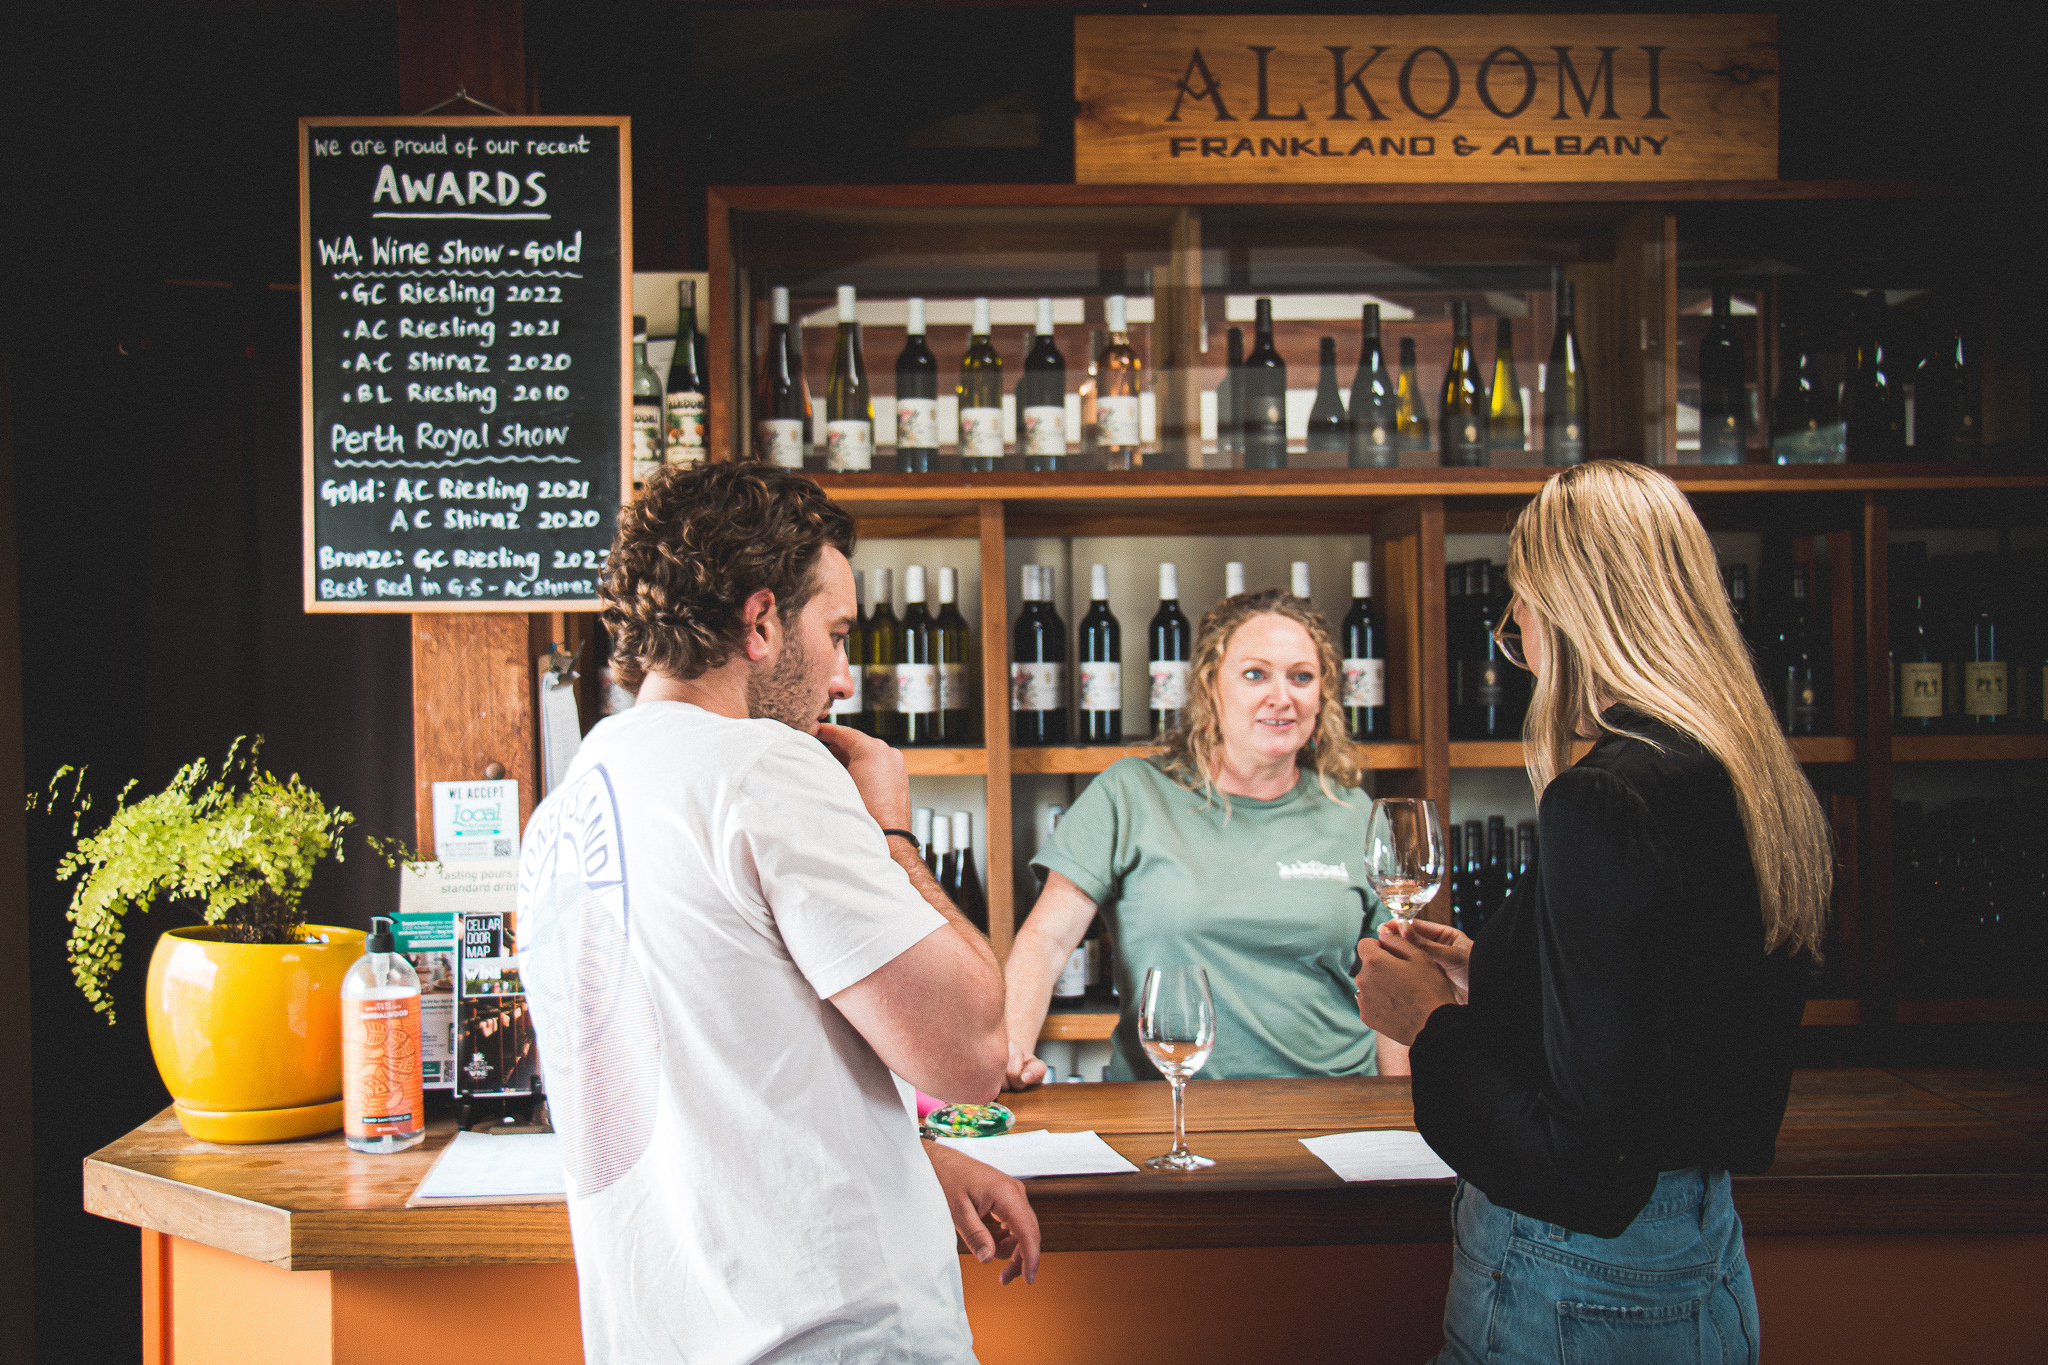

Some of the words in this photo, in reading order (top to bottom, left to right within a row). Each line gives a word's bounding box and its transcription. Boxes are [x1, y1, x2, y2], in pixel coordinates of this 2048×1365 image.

[1164, 45, 1672, 122] ALKOOMI
[351, 140, 386, 156] are
[394, 134, 448, 157] proud
[455, 138, 478, 158] of
[485, 140, 519, 154] our
[527, 134, 590, 155] recent
[1170, 136, 1436, 158] FRANKLAND
[1453, 137, 1481, 156] &
[1492, 135, 1670, 156] ALBANY
[373, 165, 547, 207] AWARDS
[372, 237, 430, 265] Wine
[352, 283, 386, 306] GC
[399, 279, 495, 316] Riesling
[507, 286, 562, 303] 2022
[355, 320, 387, 340] AC
[400, 316, 495, 347] Riesling
[510, 320, 559, 337] 2021
[408, 352, 490, 373] Shiraz
[508, 353, 571, 371] 2020
[407, 381, 497, 414] Riesling
[513, 385, 569, 401] 2010
[332, 424, 404, 454] Perth
[416, 422, 488, 456] Royal
[321, 478, 385, 507] Gold:
[438, 477, 528, 512] Riesling
[538, 480, 589, 499] 2021
[444, 508, 520, 529] Shiraz
[538, 510, 600, 529] 2020
[319, 545, 404, 570] Bronze:
[413, 549, 448, 572] GC
[453, 547, 540, 582] Riesling
[320, 577, 368, 599] Best
[376, 574, 413, 596] Red
[421, 577, 441, 596] in
[504, 580, 530, 597] AC
[449, 788, 461, 799] WE
[468, 786, 504, 799] ACCEPT
[441, 882, 490, 894] standard
[494, 882, 518, 892] drin
[482, 870, 512, 882] pours
[466, 918, 501, 931] CELLAR
[466, 931, 491, 944] DOOR
[466, 945, 491, 958] MAP
[360, 1009, 408, 1020] SANDALWOOD
